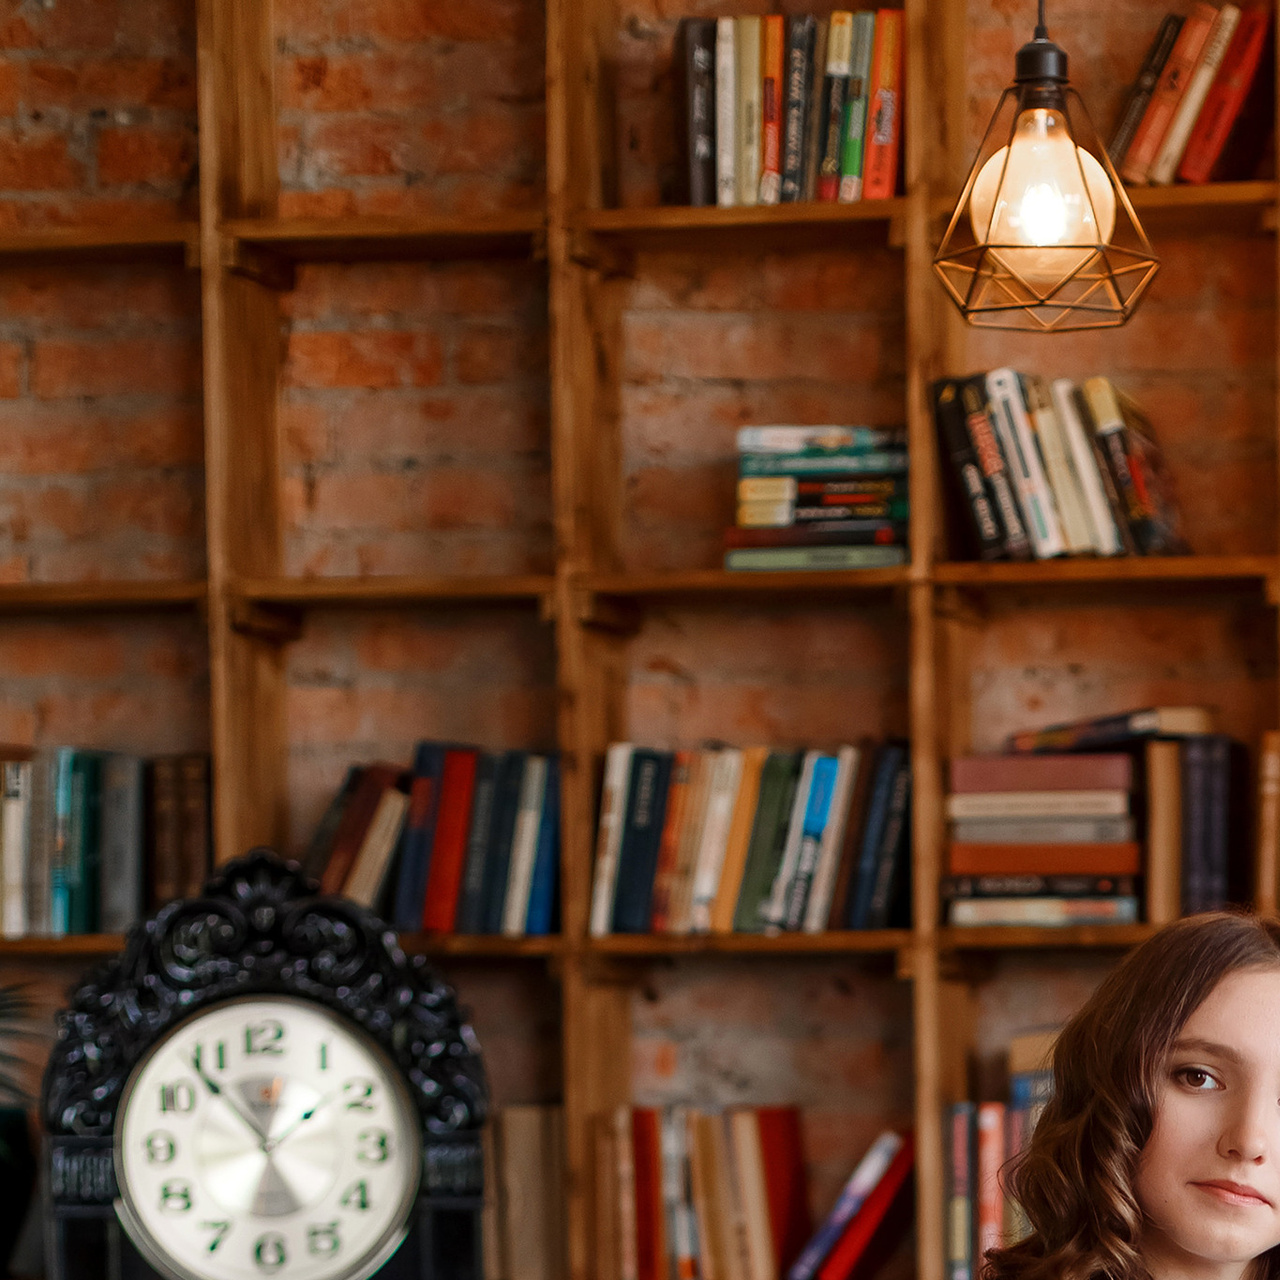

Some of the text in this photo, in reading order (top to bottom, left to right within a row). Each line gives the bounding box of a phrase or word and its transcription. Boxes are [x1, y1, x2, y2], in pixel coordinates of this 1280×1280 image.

[245, 1019, 284, 1055] 12
[195, 1042, 227, 1071] 11
[319, 1042, 329, 1072] 1
[160, 1078, 196, 1114] 10
[343, 1077, 376, 1112] 2
[146, 1128, 176, 1165] 9
[357, 1127, 389, 1165] 3
[159, 1177, 193, 1213] 8
[341, 1179, 371, 1211] 4
[199, 1219, 233, 1254] 7
[253, 1231, 287, 1273] 6
[307, 1219, 341, 1258] 5
